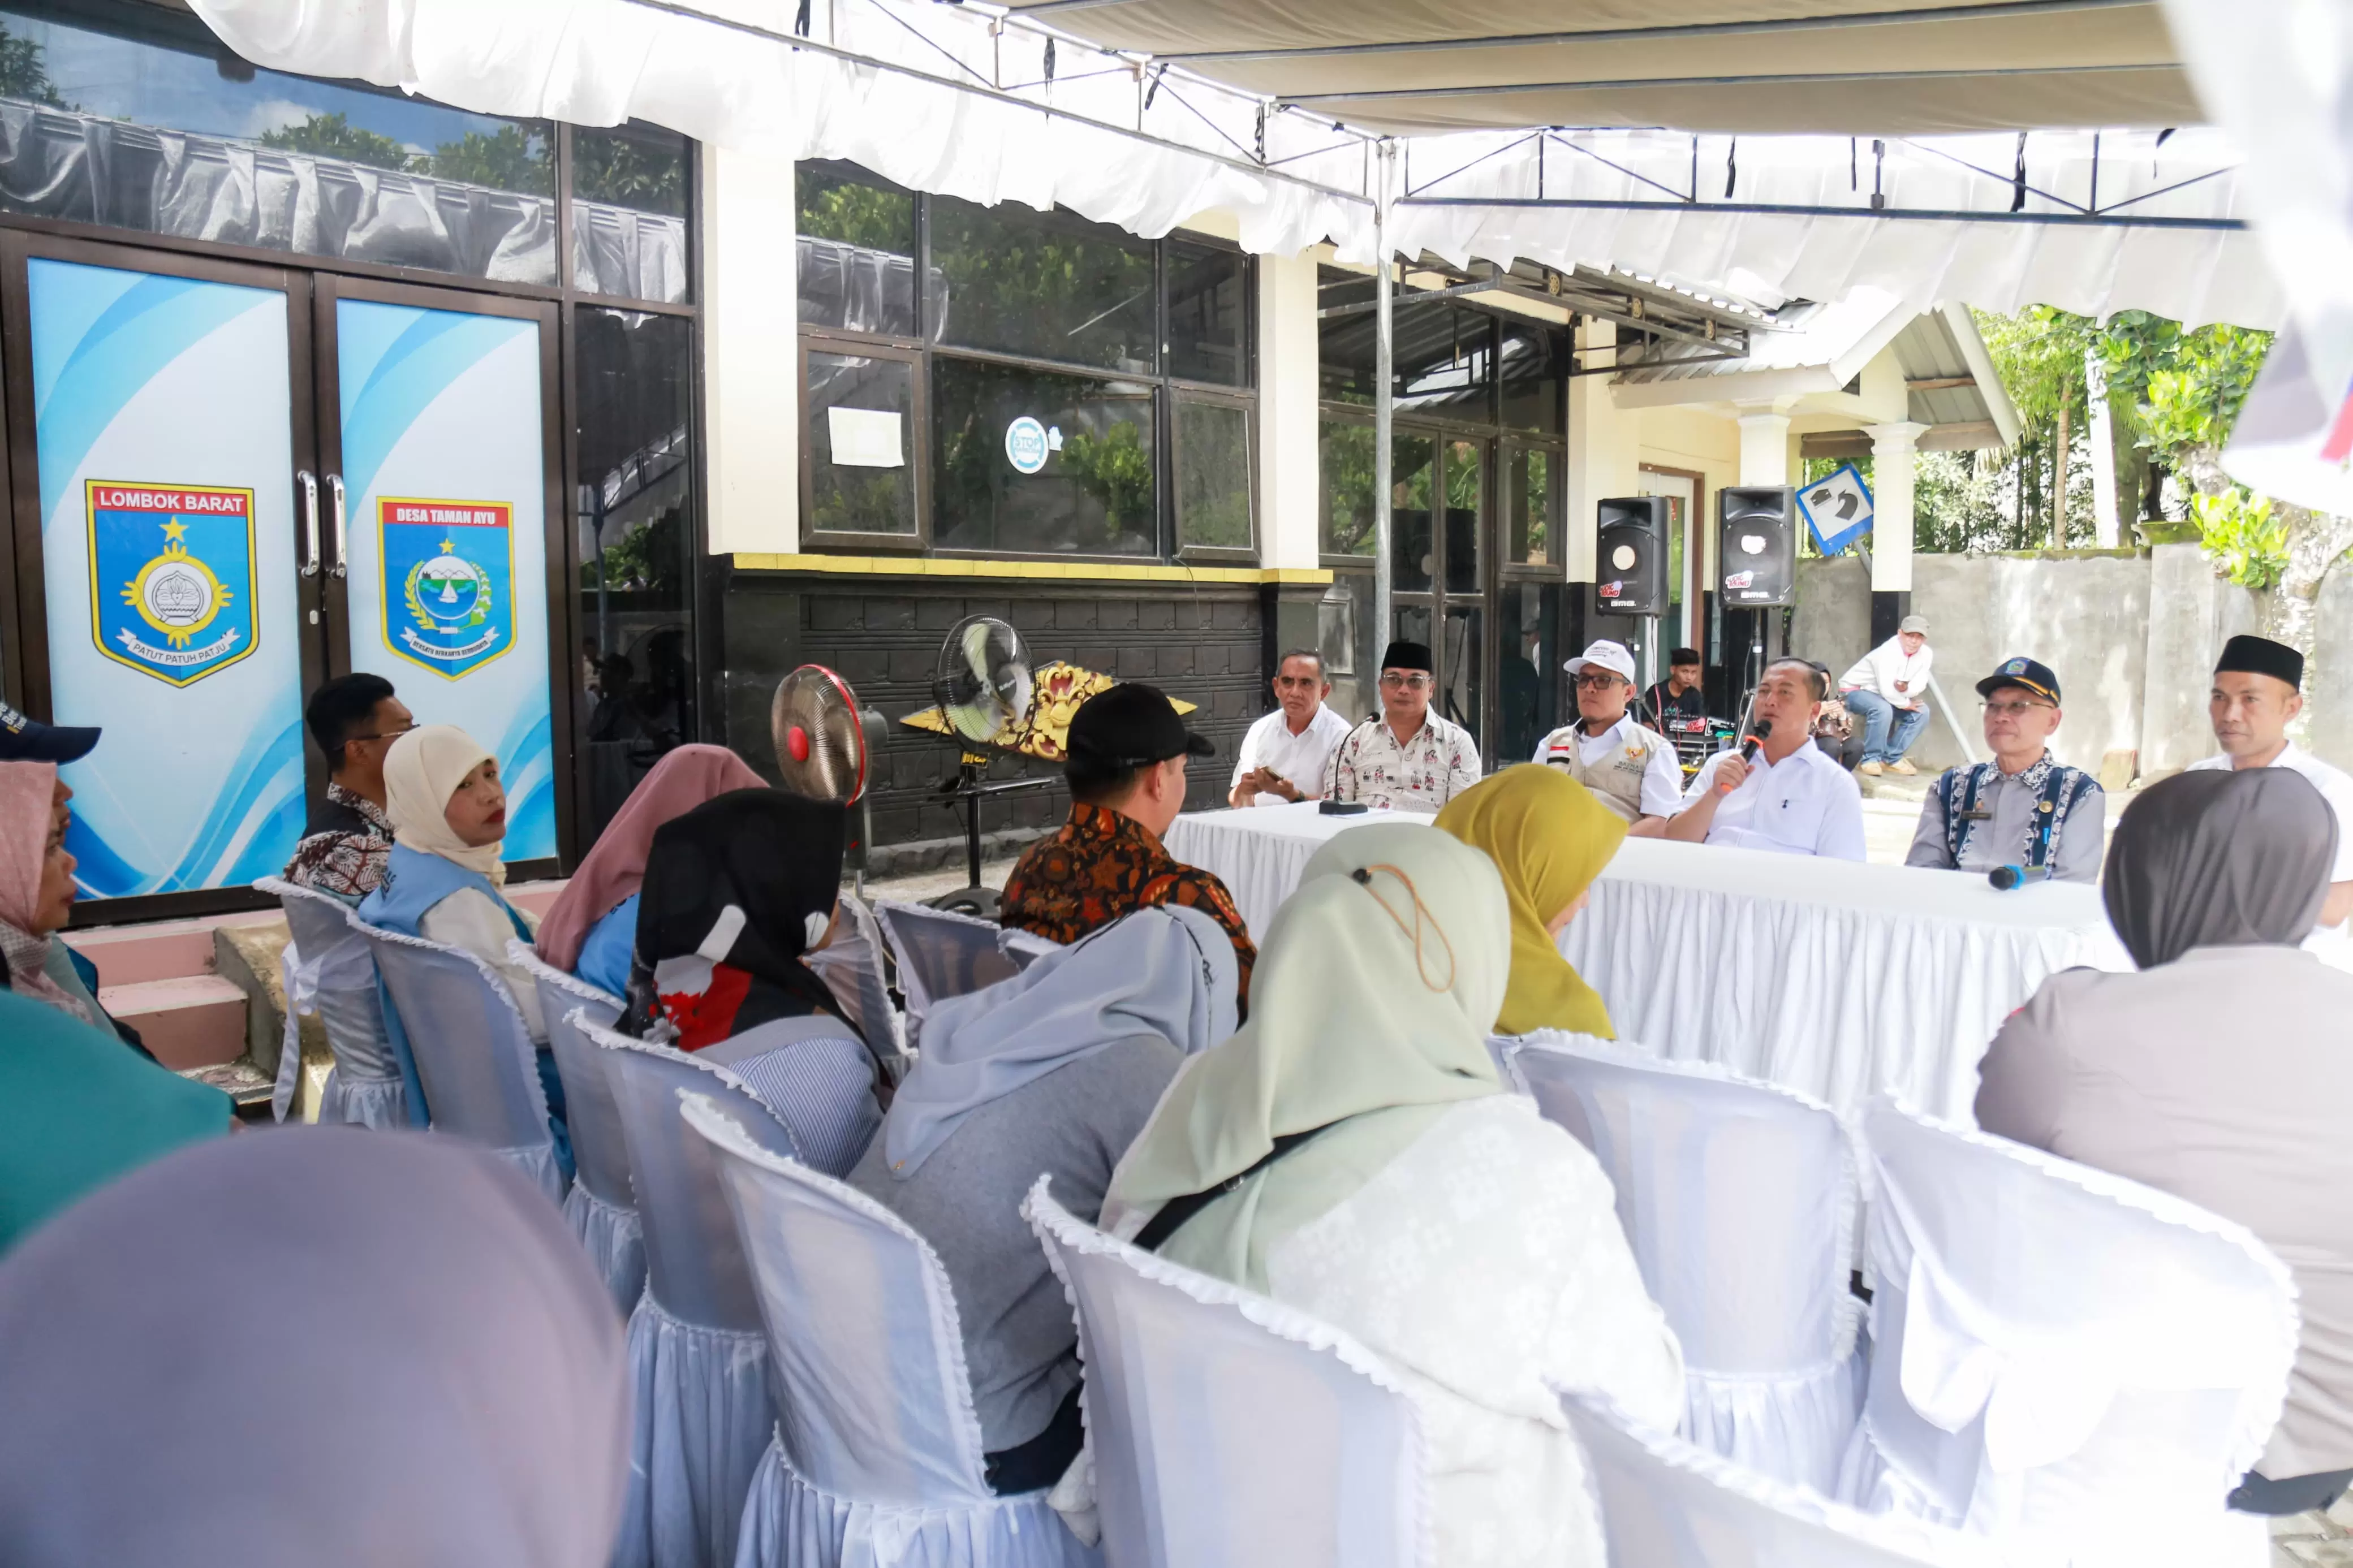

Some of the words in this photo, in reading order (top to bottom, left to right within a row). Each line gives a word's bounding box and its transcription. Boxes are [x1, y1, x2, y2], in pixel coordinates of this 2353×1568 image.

[1015, 436, 1039, 447] STOP
[100, 490, 180, 510] LOMBOK
[185, 495, 243, 512] BARAT
[397, 508, 428, 522] DESA
[430, 509, 472, 524] TAMAN
[473, 511, 496, 525] AYU
[133, 642, 165, 661] PATUT
[165, 654, 197, 664] PATUH
[199, 643, 227, 659] PATJU
[412, 640, 434, 655] BERSATU
